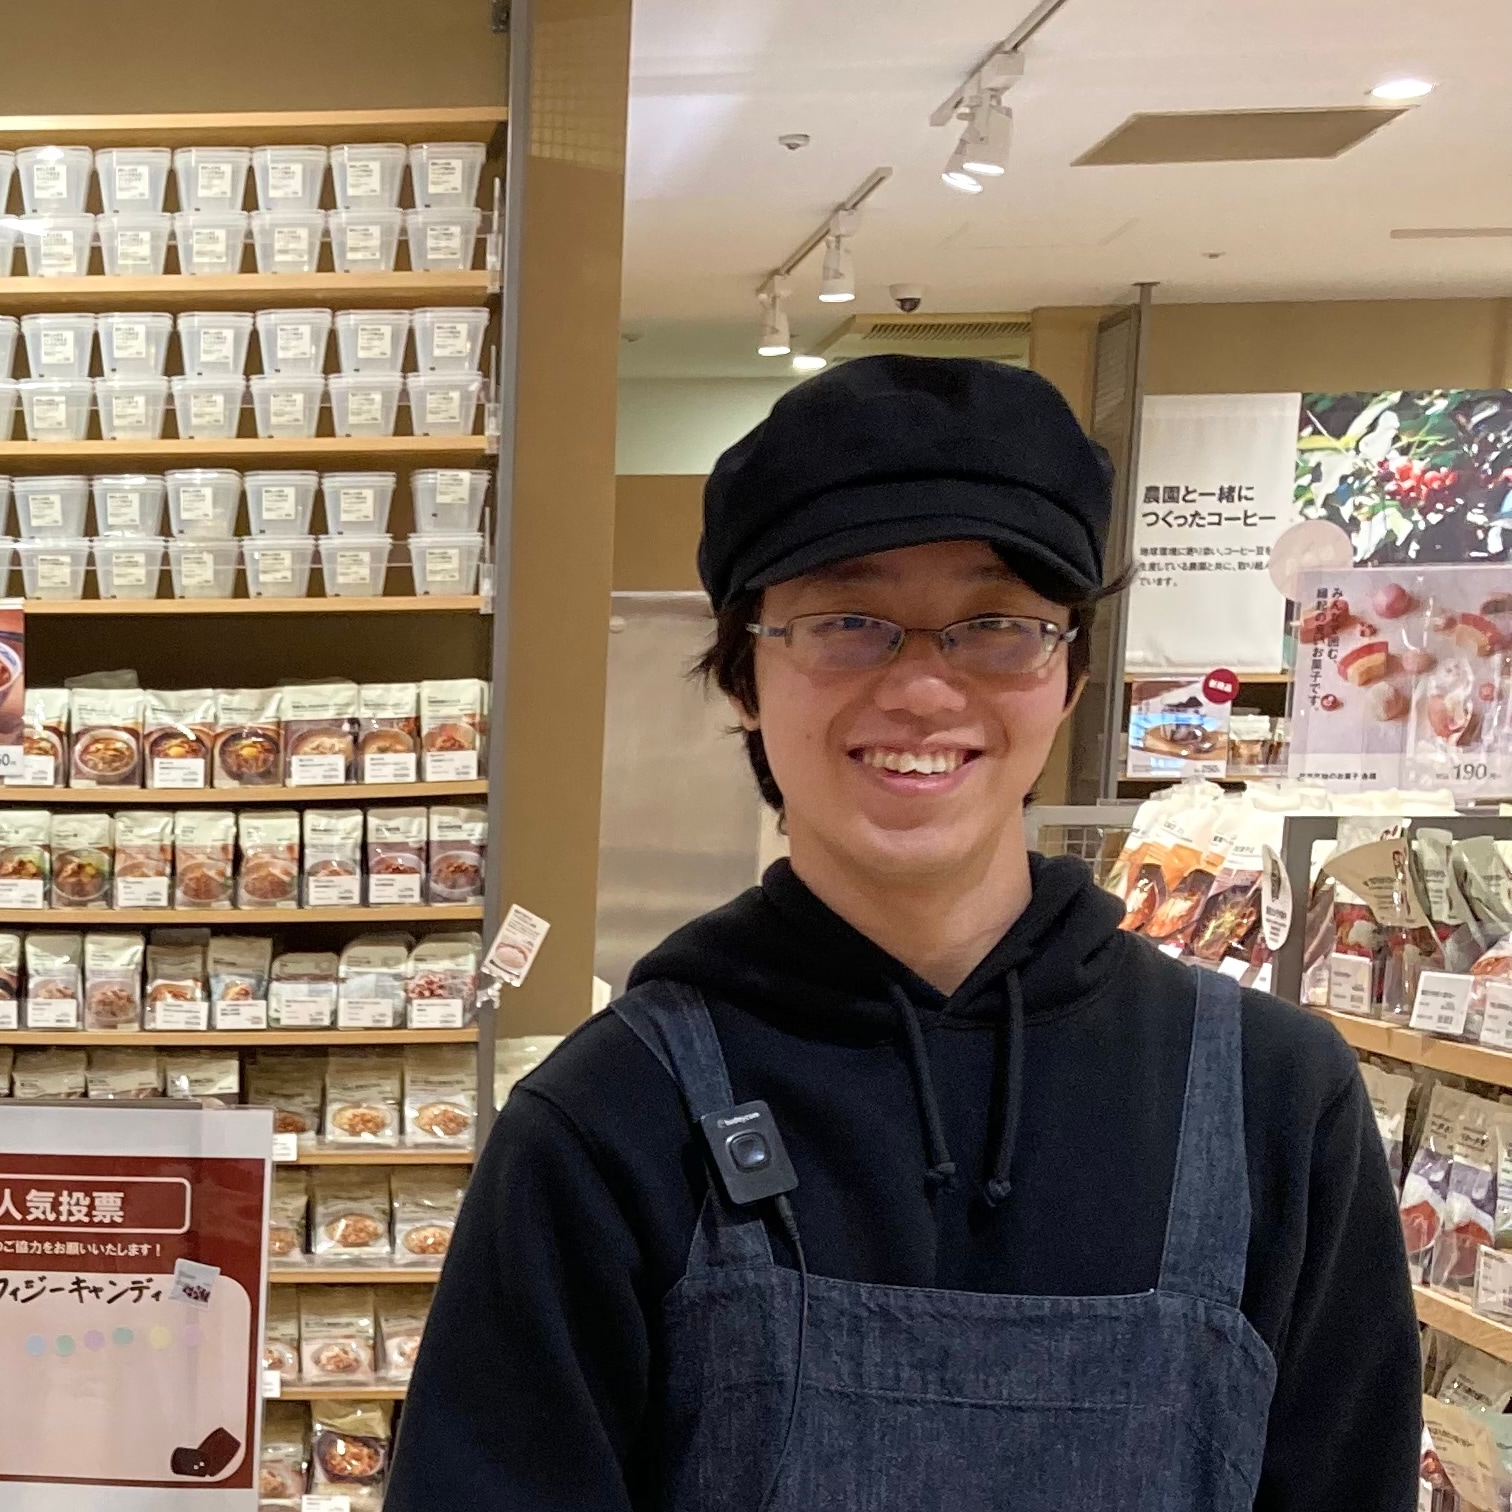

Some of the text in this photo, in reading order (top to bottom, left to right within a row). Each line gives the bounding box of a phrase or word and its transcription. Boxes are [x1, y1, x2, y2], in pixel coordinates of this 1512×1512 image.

[1143, 485, 1254, 504] 農園と一緒に
[1141, 509, 1277, 529] つくったコーヒー
